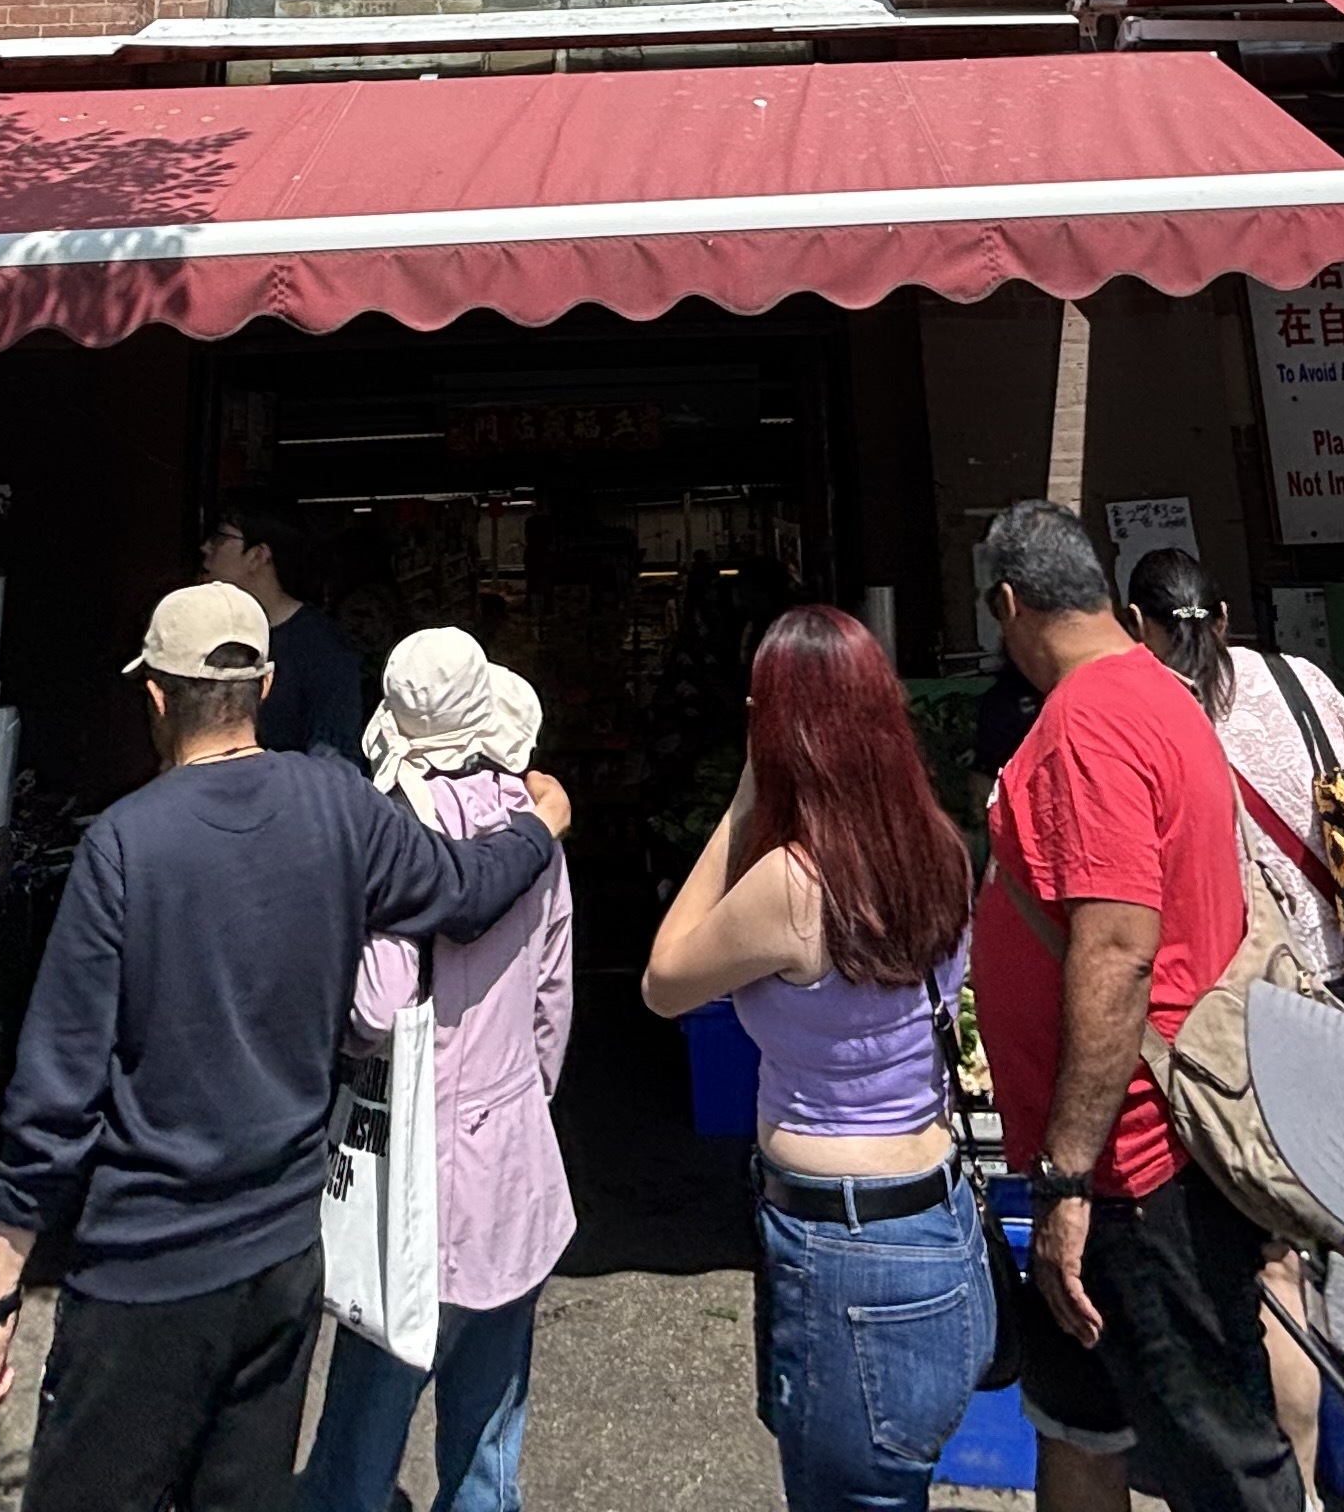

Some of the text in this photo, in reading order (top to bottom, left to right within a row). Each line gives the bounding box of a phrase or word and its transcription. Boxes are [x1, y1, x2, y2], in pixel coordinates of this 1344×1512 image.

[1277, 364, 1295, 383] To
[1299, 363, 1337, 383] Avoid
[1287, 470, 1324, 497] Not
